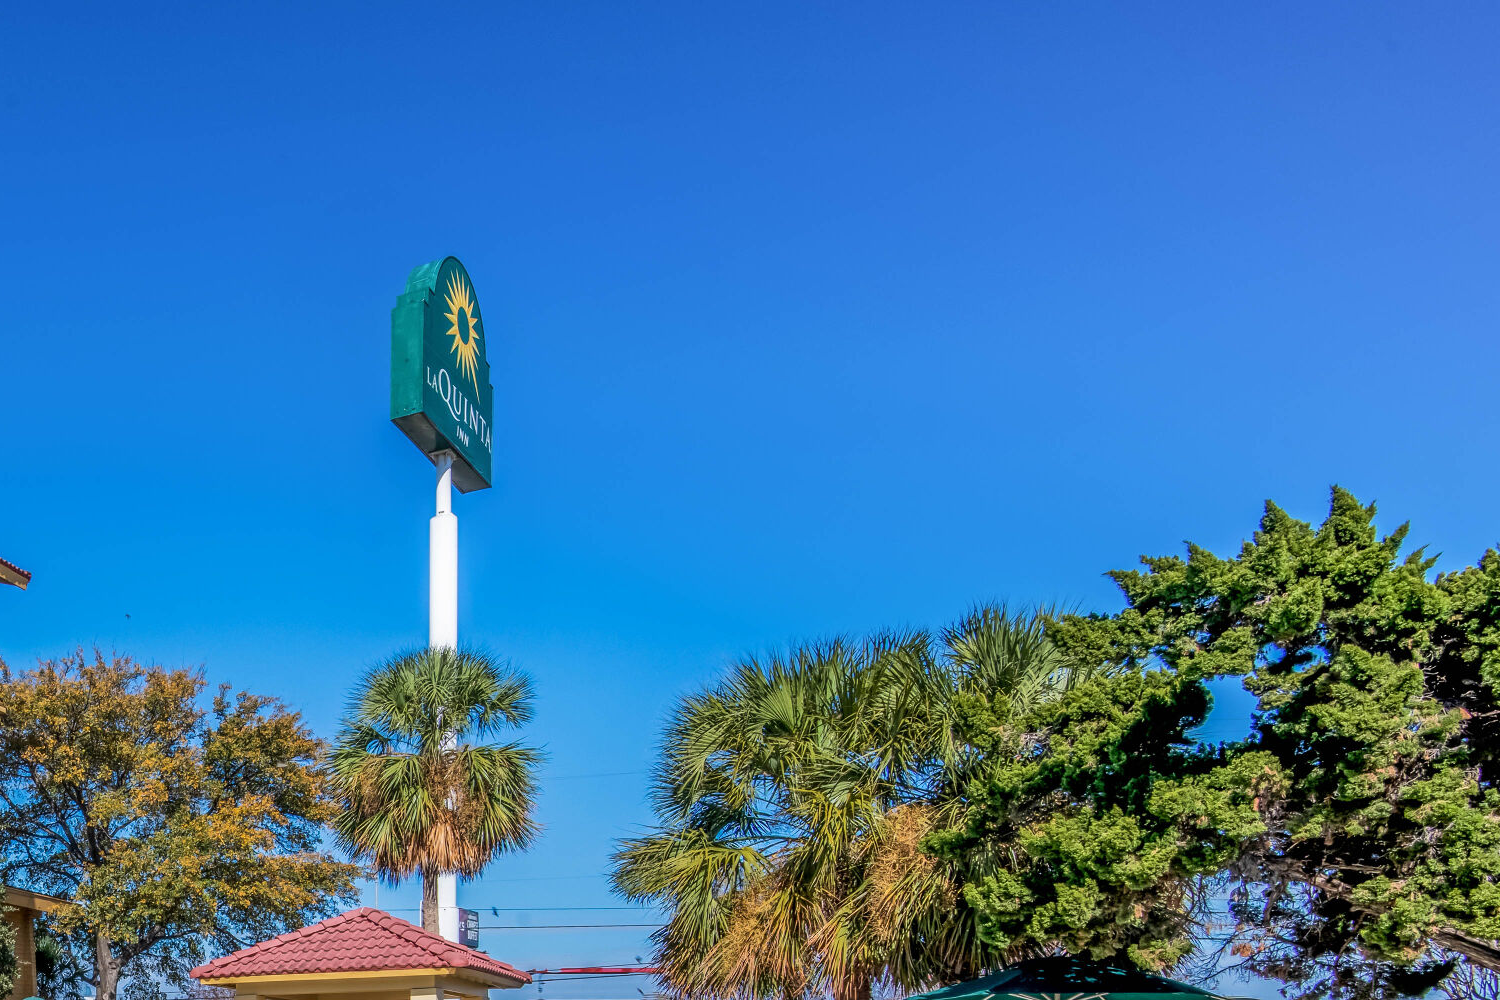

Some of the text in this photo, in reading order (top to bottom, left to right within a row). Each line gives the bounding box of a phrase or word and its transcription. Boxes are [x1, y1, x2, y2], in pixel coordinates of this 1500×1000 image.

[427, 366, 492, 454] LA QUINTA
[456, 425, 469, 447] INN
